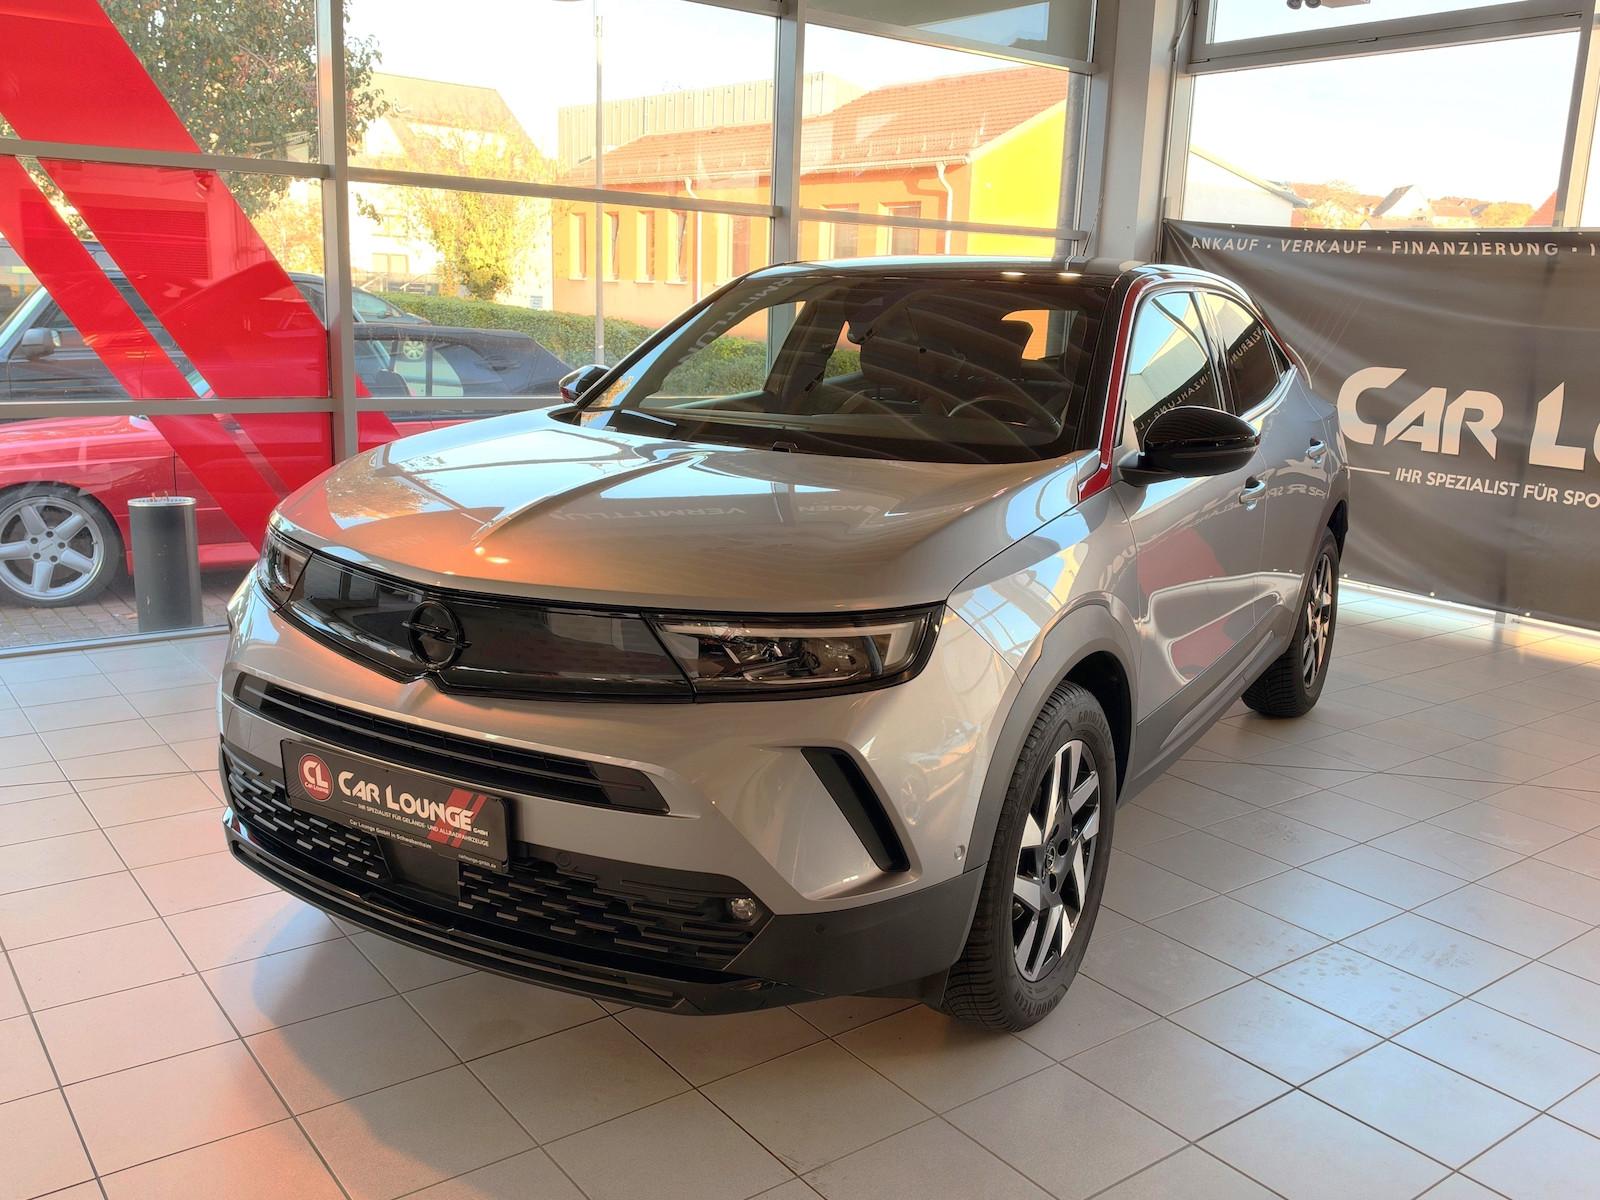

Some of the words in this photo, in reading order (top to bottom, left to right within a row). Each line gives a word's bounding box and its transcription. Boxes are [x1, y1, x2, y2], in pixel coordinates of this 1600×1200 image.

[1191, 236, 1259, 253] ANKAUF
[1280, 239, 1368, 255] VERKAUF
[1391, 240, 1559, 257] FINANZIERUNG
[1336, 366, 1504, 461] CAR
[1528, 381, 1600, 471] L
[1395, 467, 1423, 483] IHR
[1426, 471, 1520, 497] SPEZIALIST
[1523, 482, 1559, 503] FÜR
[303, 760, 329, 788] CL
[338, 771, 381, 804] CAR
[385, 785, 474, 831] LOUNGE
[358, 821, 375, 832] Lounge
[366, 806, 392, 818] SPEZIALIST
[391, 812, 402, 821] FÜR
[427, 824, 439, 832] UND
[439, 827, 489, 847] ALLRADFAHRZEUGE
